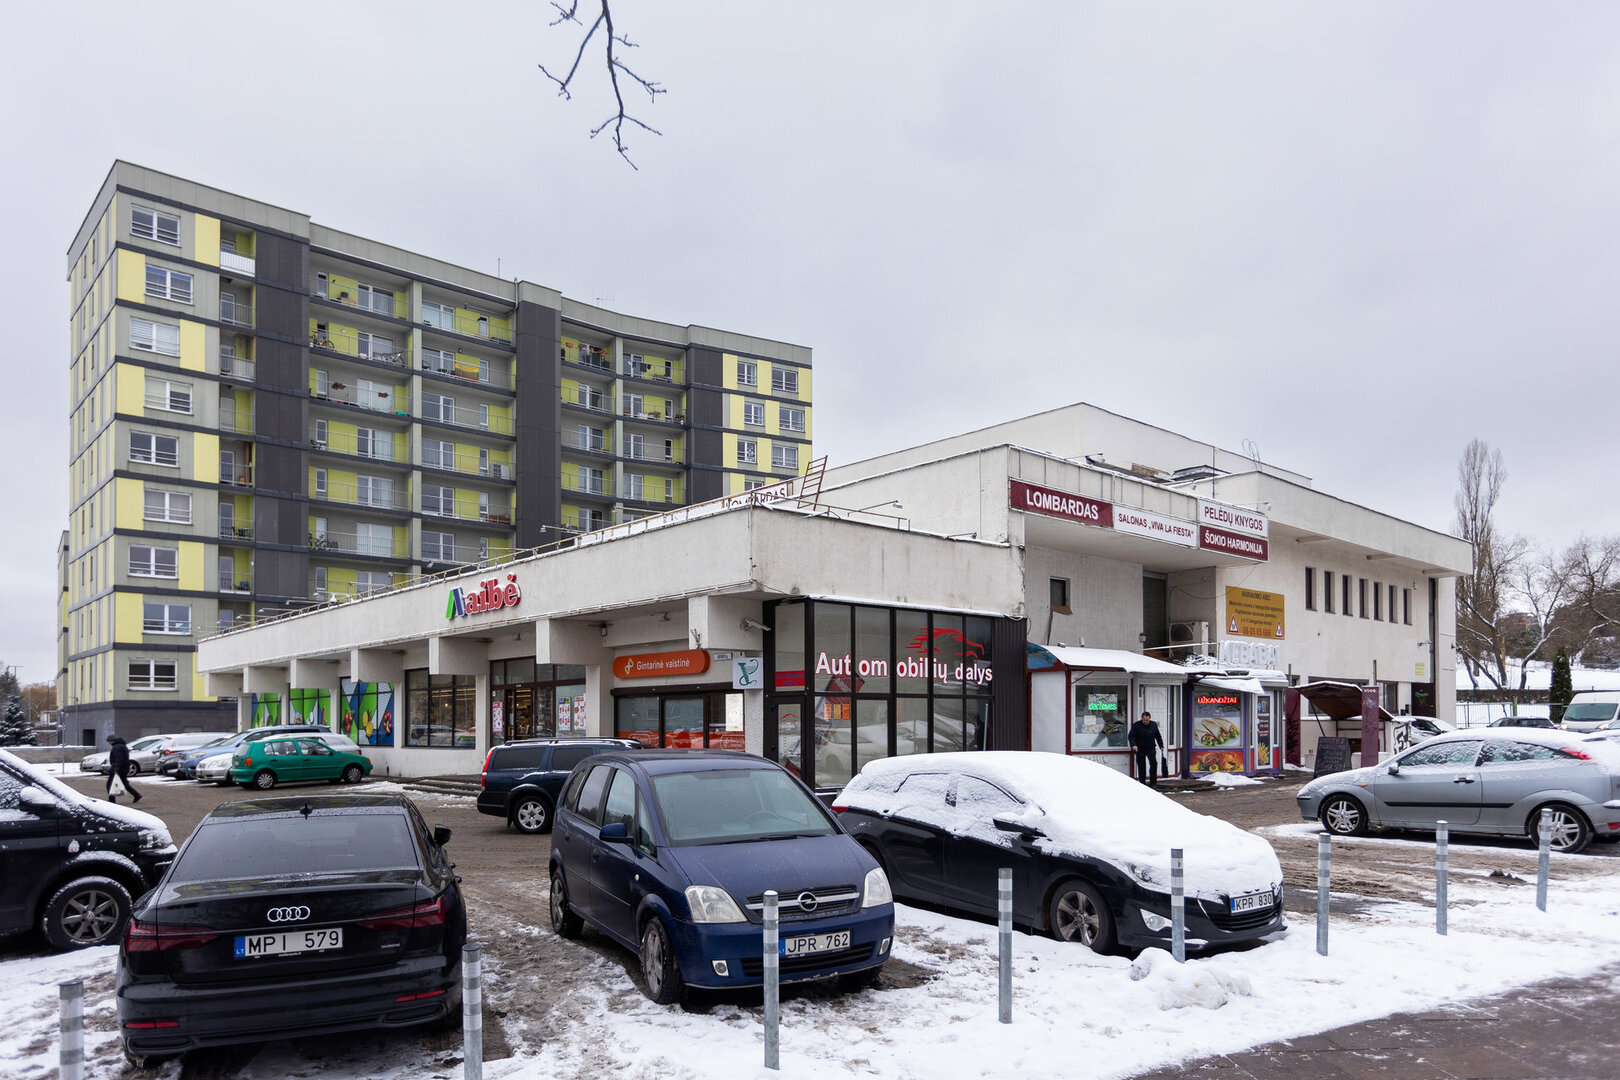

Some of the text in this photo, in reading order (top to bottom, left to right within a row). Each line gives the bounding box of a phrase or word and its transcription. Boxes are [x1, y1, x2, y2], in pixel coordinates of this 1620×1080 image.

[1026, 489, 1099, 520] LOMBARDAS
[1118, 513, 1148, 528] SALONAS
[1164, 524, 1172, 534] LA
[1204, 506, 1264, 531] PELĖDŲ KNYGOS
[1204, 530, 1264, 555] ŠOKIO HARMONIJA
[636, 658, 690, 670] Gintarinė vaistinė
[1197, 695, 1237, 704] UŽKANDŽIAI
[1236, 893, 1272, 910] KPR 830
[248, 934, 286, 954] MPI
[304, 930, 339, 949] 579
[787, 937, 817, 953] JPR
[826, 933, 849, 949] 762
